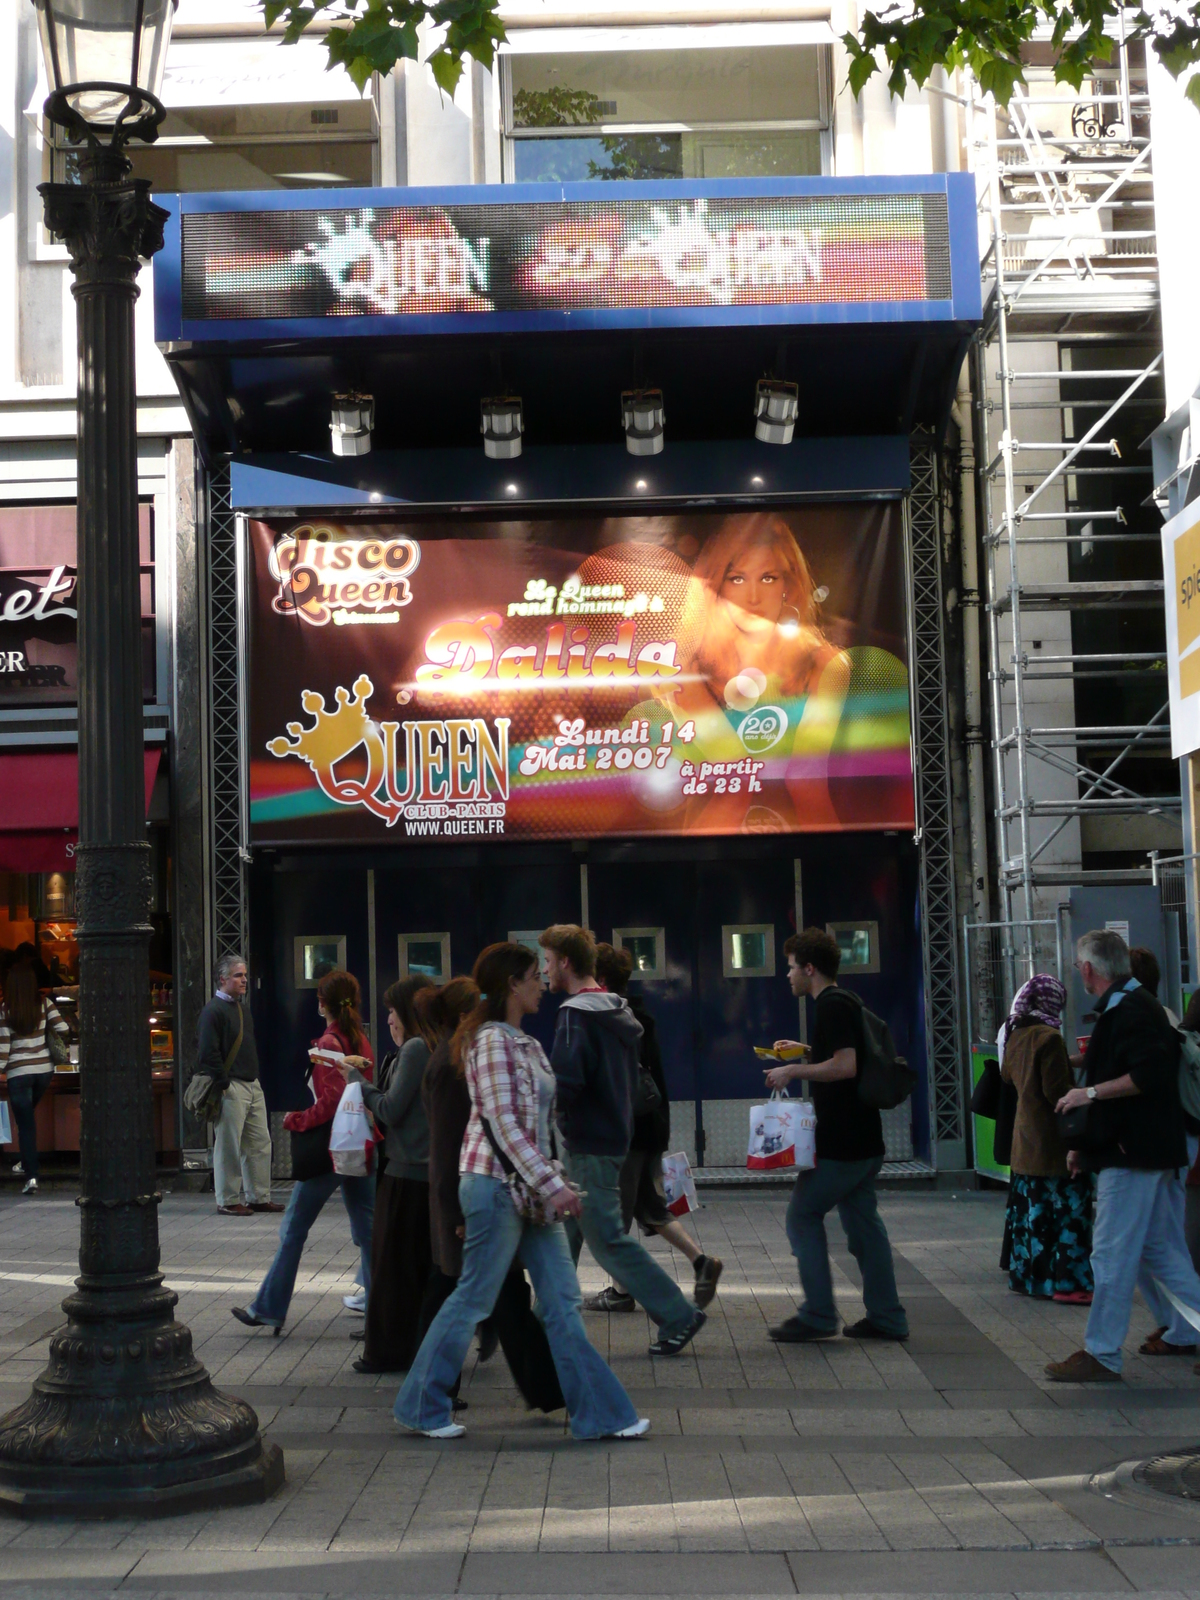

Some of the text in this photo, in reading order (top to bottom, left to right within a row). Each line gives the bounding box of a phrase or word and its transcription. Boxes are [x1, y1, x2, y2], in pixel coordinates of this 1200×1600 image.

[312, 222, 490, 314] QUEEN
[272, 526, 416, 573] disco
[0, 565, 77, 621] et
[273, 565, 412, 624] Queen
[560, 578, 625, 602] Queen
[508, 600, 553, 616] rend
[415, 613, 682, 683] Dalida
[554, 718, 696, 747] Lundi 14
[745, 717, 777, 734] 20
[292, 704, 510, 827] QUEEN
[519, 745, 672, 776] Mai 2007
[680, 758, 764, 780] à partir
[683, 775, 762, 795] de 23 h
[404, 803, 506, 819] CLUB-PARIS
[405, 820, 504, 836] WWW.QUEEN.FR
